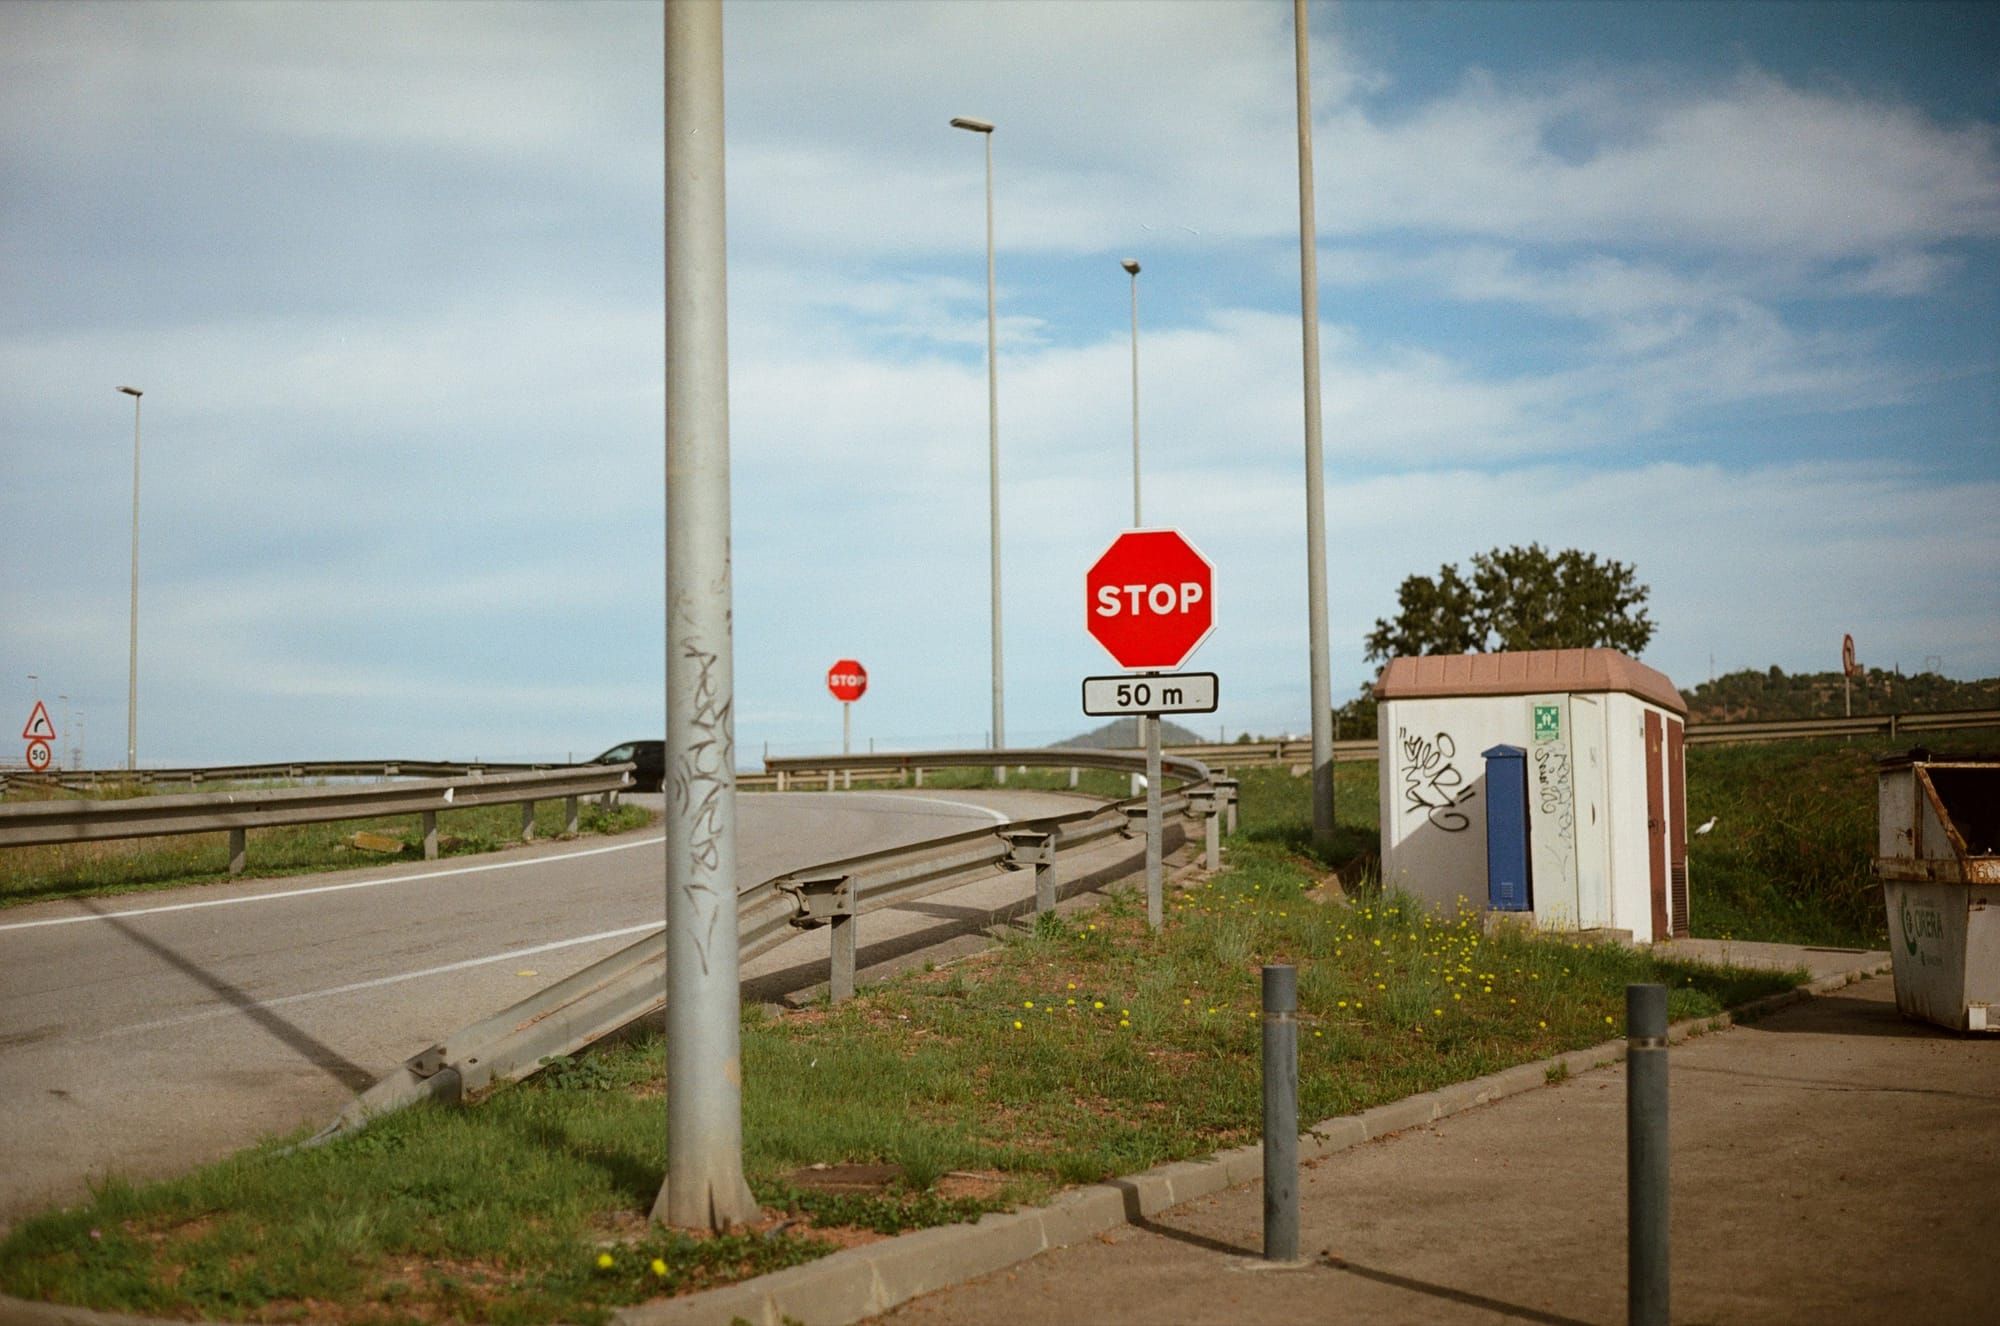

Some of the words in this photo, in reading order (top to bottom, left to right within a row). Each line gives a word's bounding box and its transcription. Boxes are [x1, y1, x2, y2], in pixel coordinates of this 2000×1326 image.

[1096, 582, 1203, 617] STOP
[830, 674, 866, 687] STOP
[1117, 684, 1151, 707] 50
[1162, 687, 1183, 705] m
[32, 750, 46, 761] 50
